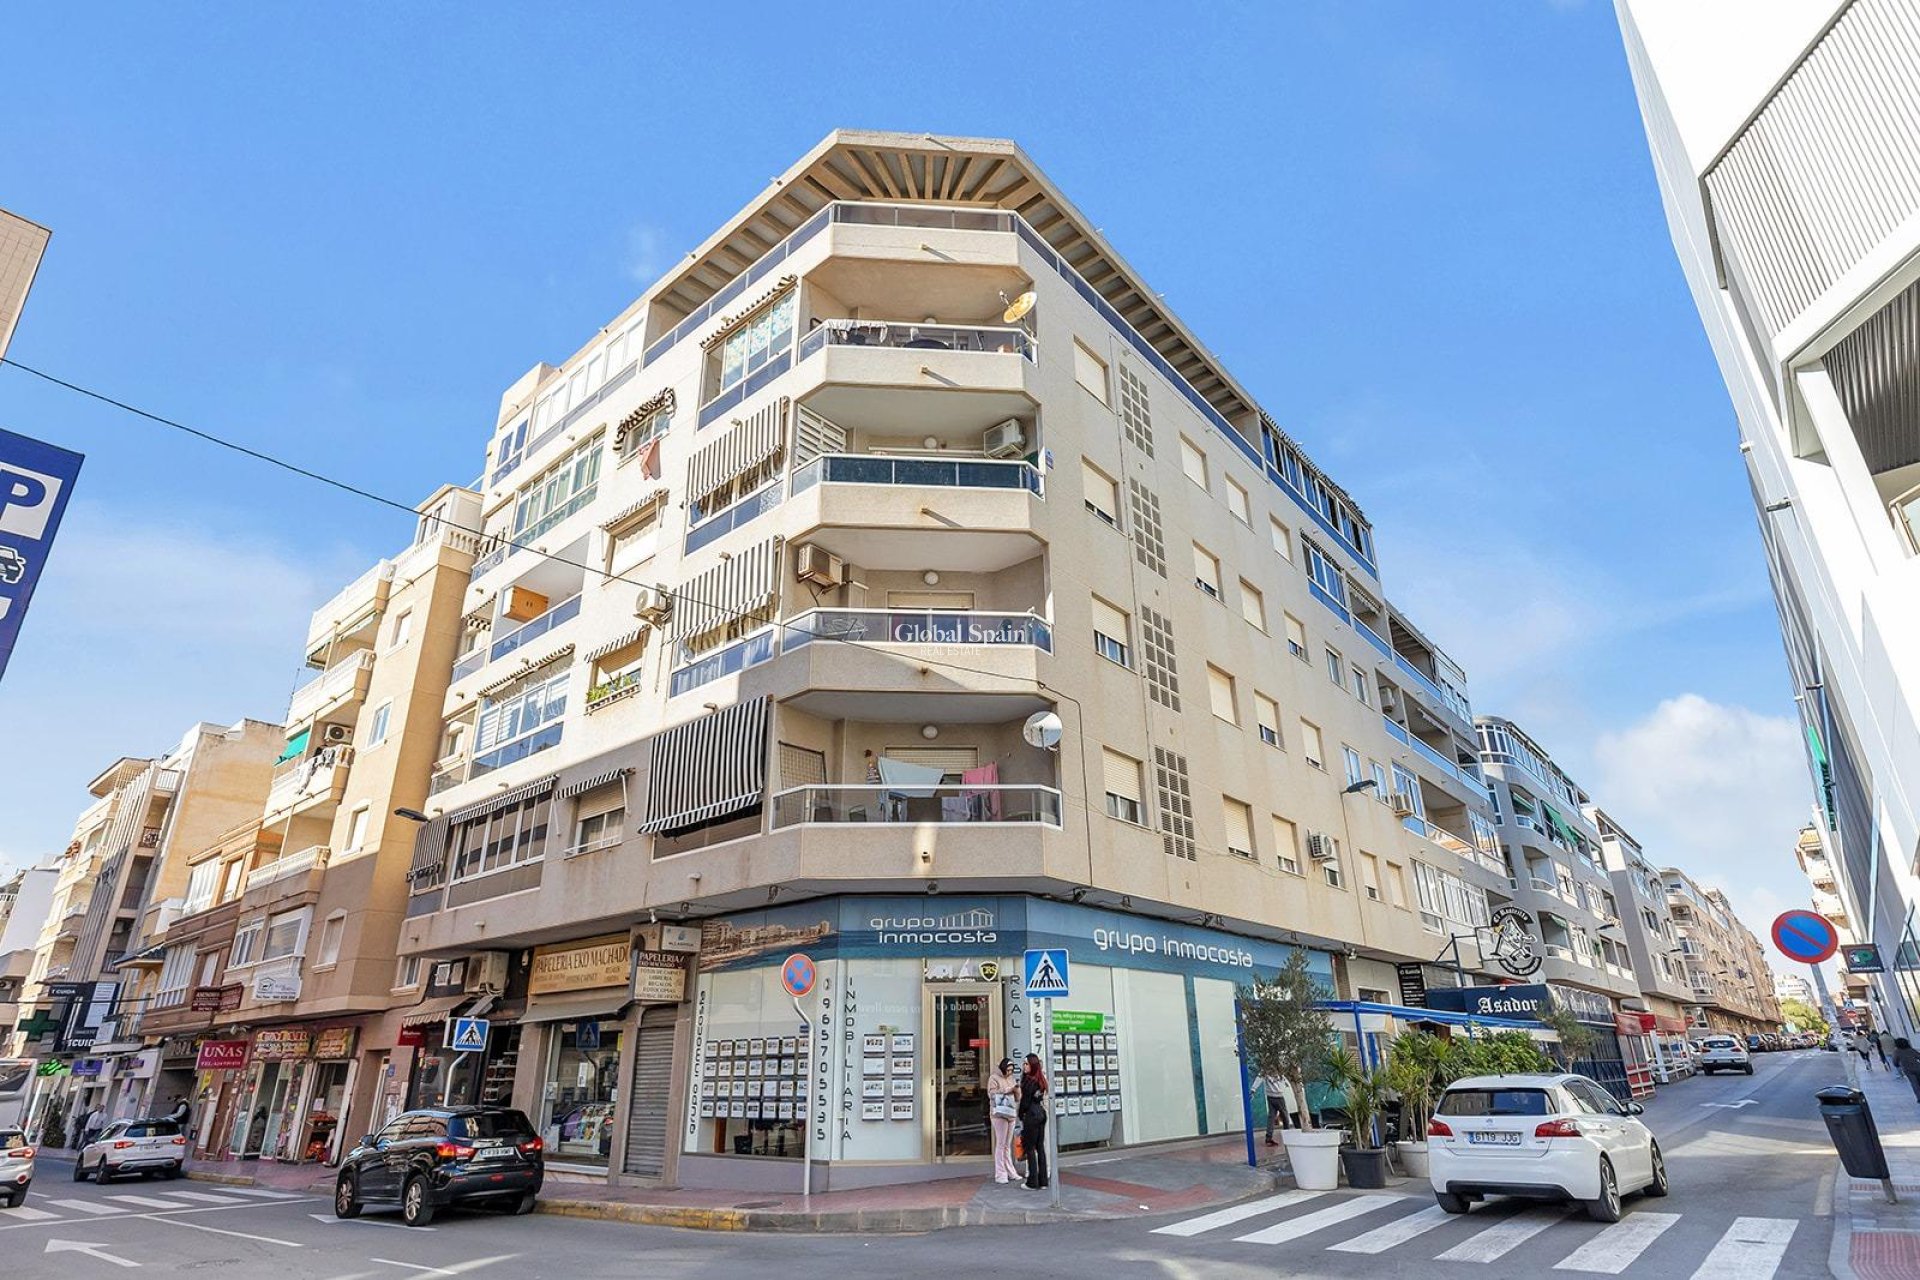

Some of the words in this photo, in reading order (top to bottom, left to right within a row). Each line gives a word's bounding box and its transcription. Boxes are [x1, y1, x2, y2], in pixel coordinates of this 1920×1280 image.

[0, 469, 46, 521] P
[870, 917, 935, 930] grupo
[879, 930, 997, 944] inmocosta
[1093, 927, 1157, 955] grupo
[1163, 935, 1254, 968] inmocosta
[1009, 975, 1022, 1029] REAL
[1477, 996, 1538, 1014] Asador
[204, 1044, 244, 1058] UÑAS
[694, 990, 706, 1077] inmocosta
[817, 998, 830, 1141] 965705535
[841, 977, 857, 1140] INMOBILIARIA
[689, 1083, 699, 1135] grupo
[1475, 1132, 1496, 1142] 6119
